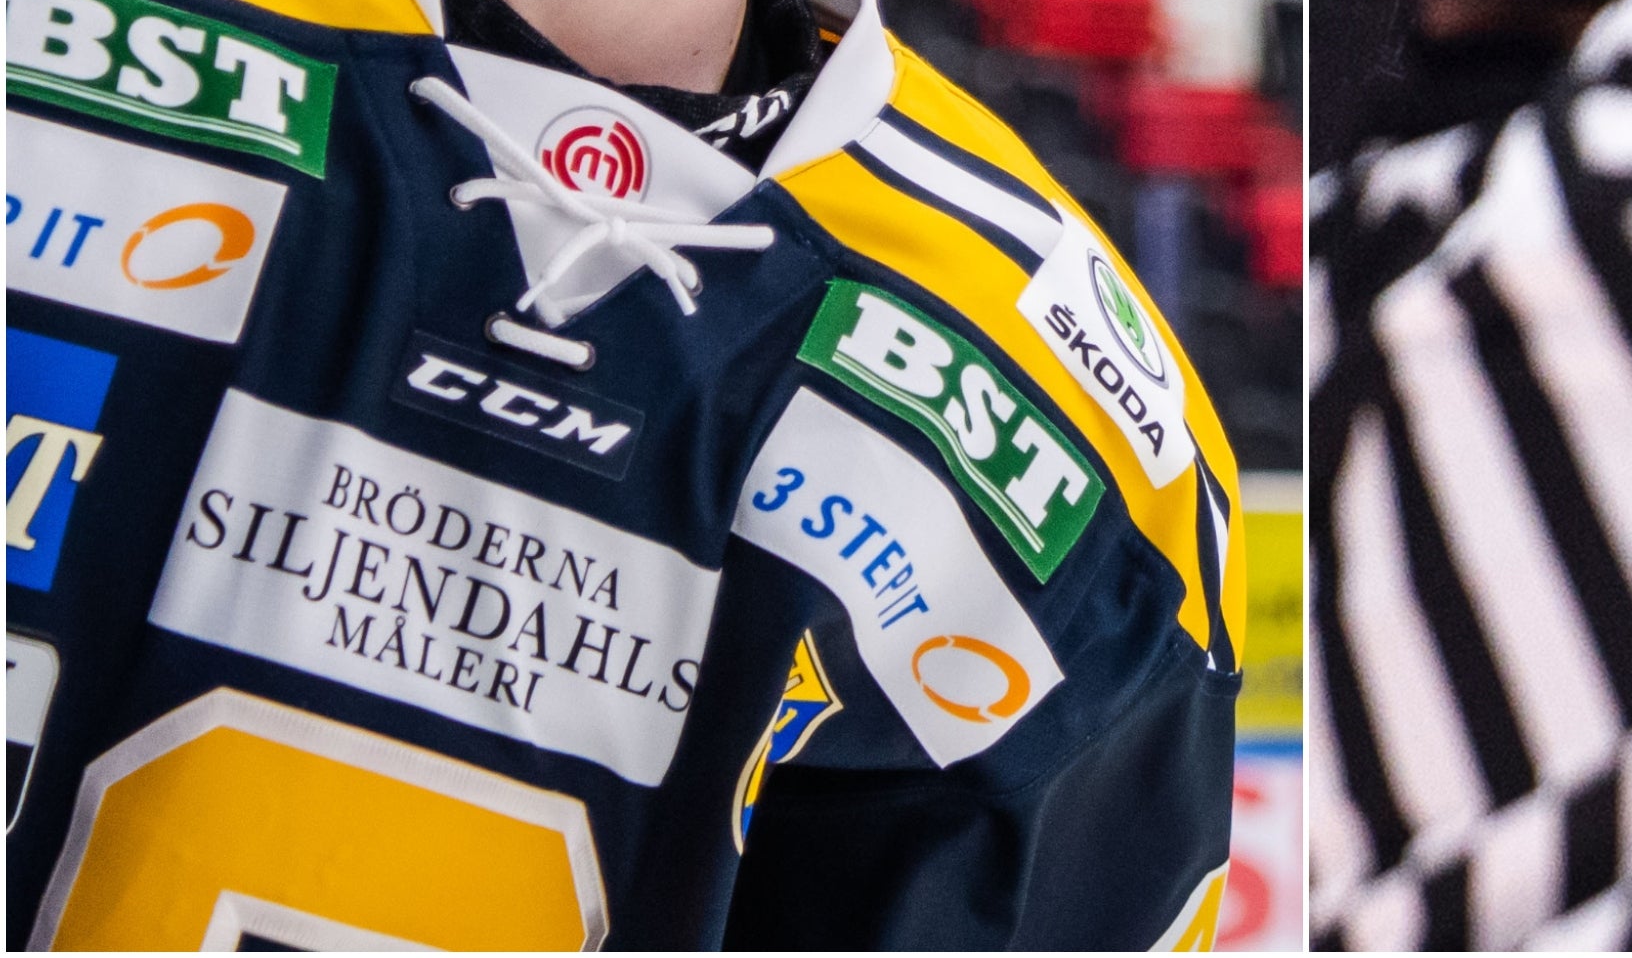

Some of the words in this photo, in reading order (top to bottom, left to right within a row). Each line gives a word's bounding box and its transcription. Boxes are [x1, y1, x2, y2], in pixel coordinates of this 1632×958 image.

[407, 352, 632, 456] CCM
[833, 291, 1090, 529] BST
[1044, 303, 1167, 459] ŠKODA
[185, 488, 701, 713] SILJENDAHLS
[321, 464, 621, 612] BRÖDERNA
[752, 466, 806, 513] 3
[800, 494, 930, 631] STEPIT
[325, 604, 545, 714] MÅLERI
